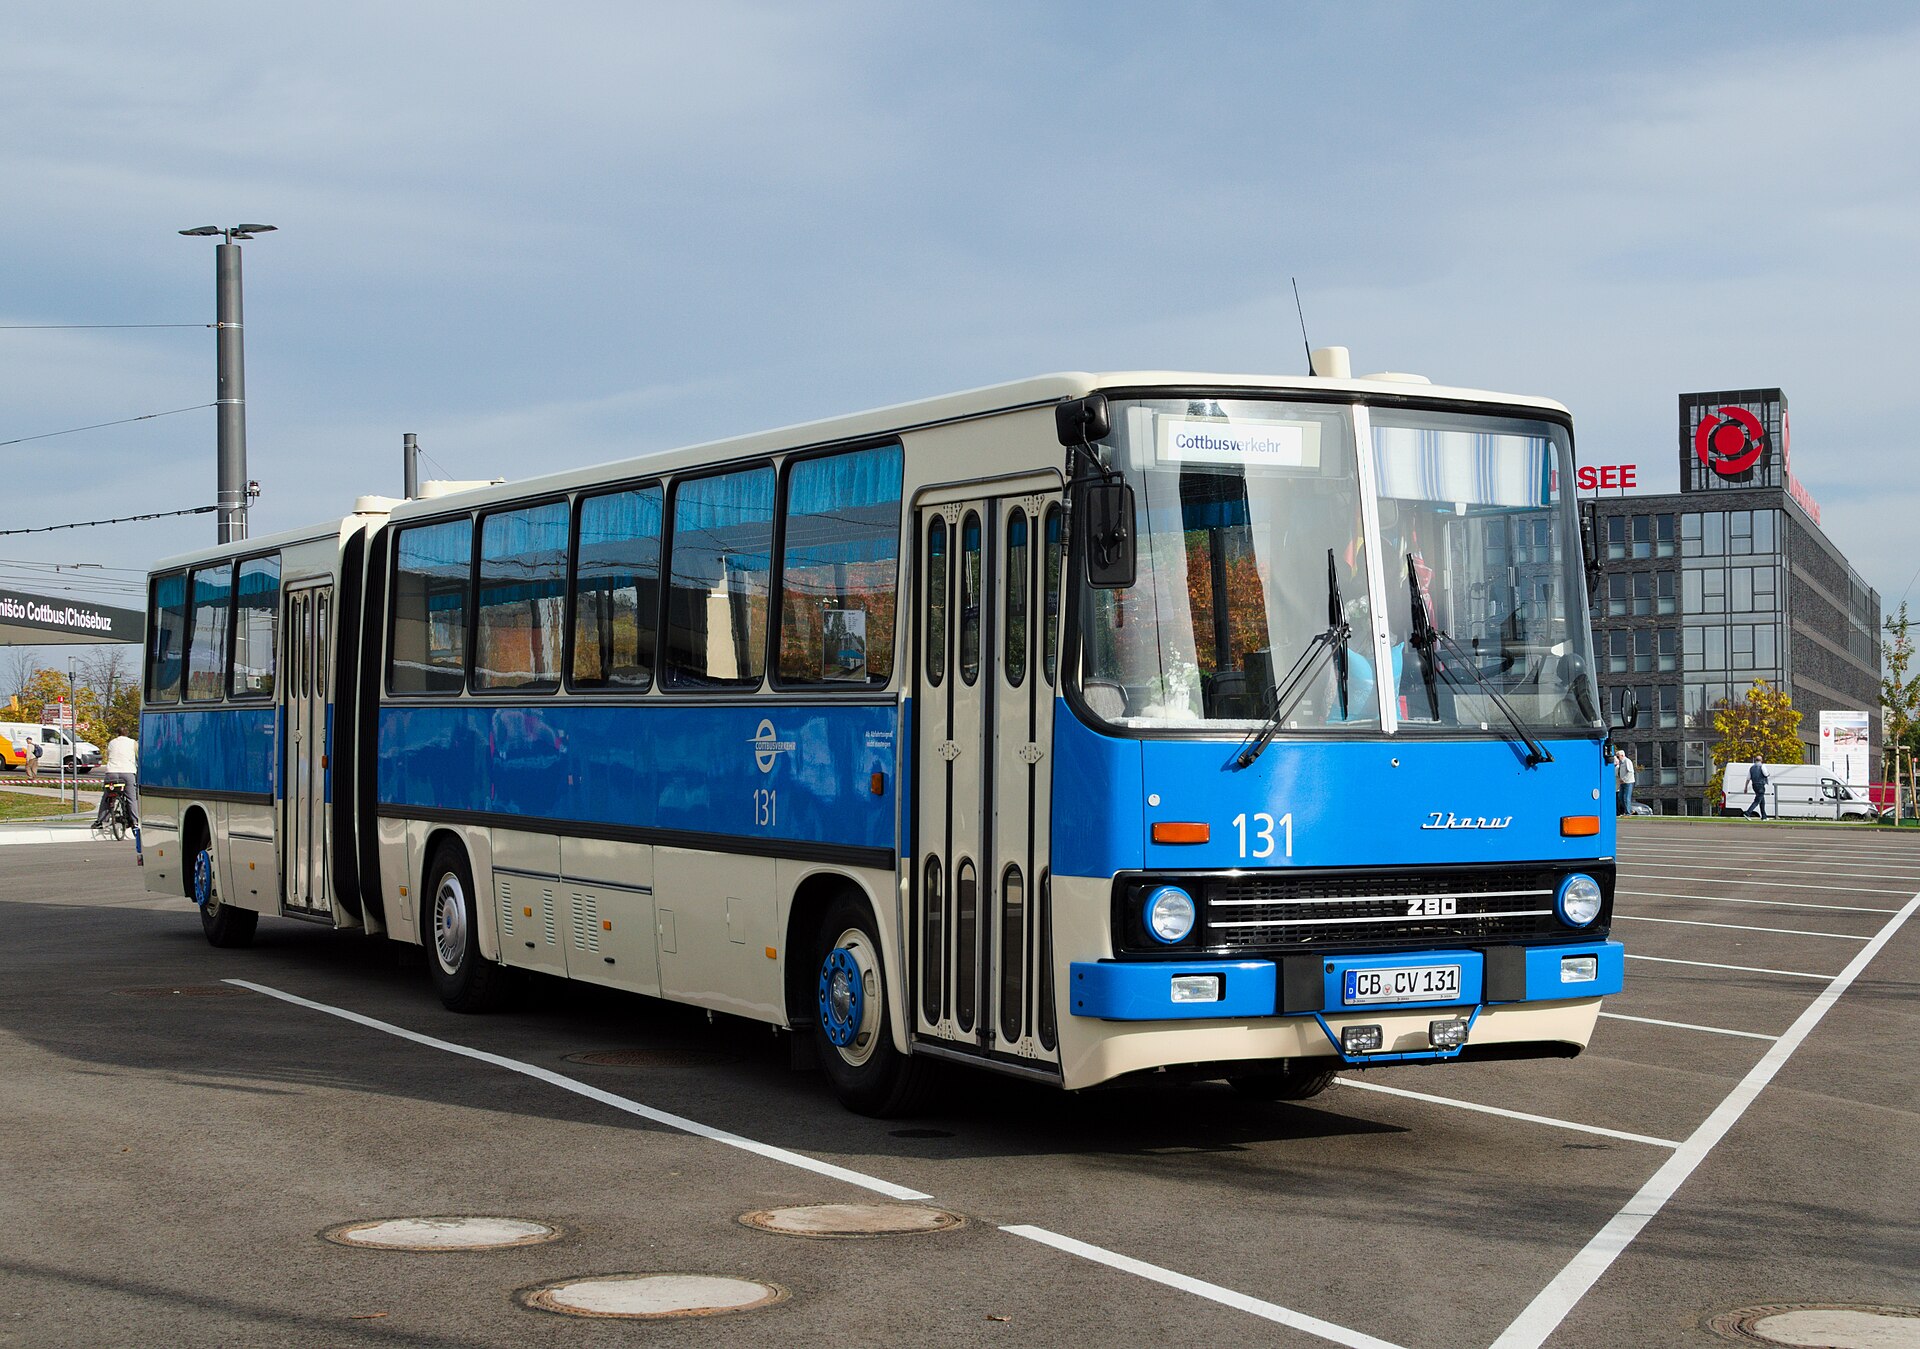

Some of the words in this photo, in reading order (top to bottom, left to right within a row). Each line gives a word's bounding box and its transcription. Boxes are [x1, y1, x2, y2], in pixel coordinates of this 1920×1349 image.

[1175, 433, 1281, 453] Cottbusverkehr
[1577, 464, 1637, 490] SEE
[753, 788, 776, 826] 131
[1421, 812, 1513, 829] Ikarus
[1232, 812, 1293, 858] 131
[1348, 987, 1354, 995] D
[1357, 974, 1381, 995] CB
[1395, 972, 1419, 993] CV
[1423, 970, 1457, 992] 131
